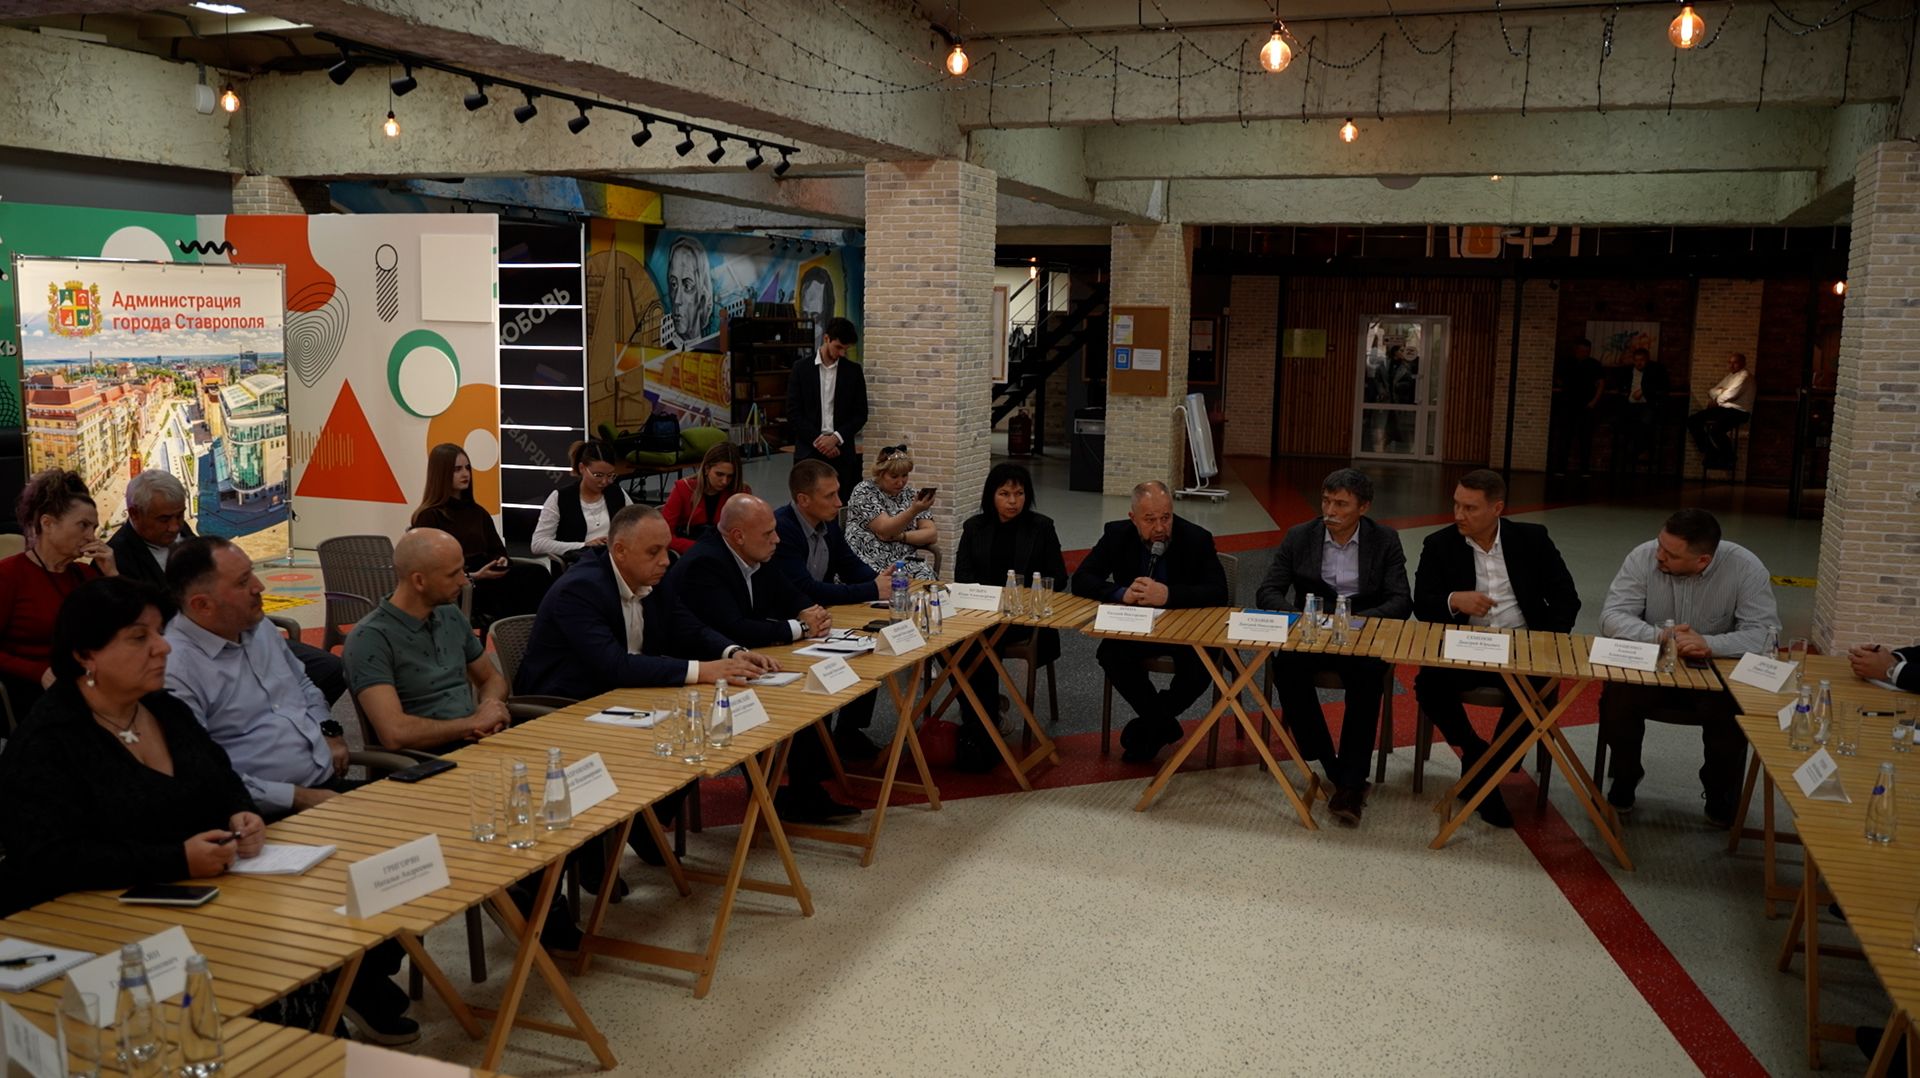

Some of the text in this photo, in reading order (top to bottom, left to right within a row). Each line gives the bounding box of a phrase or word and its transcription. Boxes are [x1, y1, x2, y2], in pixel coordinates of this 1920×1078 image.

[112, 290, 242, 312] Администрация
[113, 313, 265, 334] города Ставрополя
